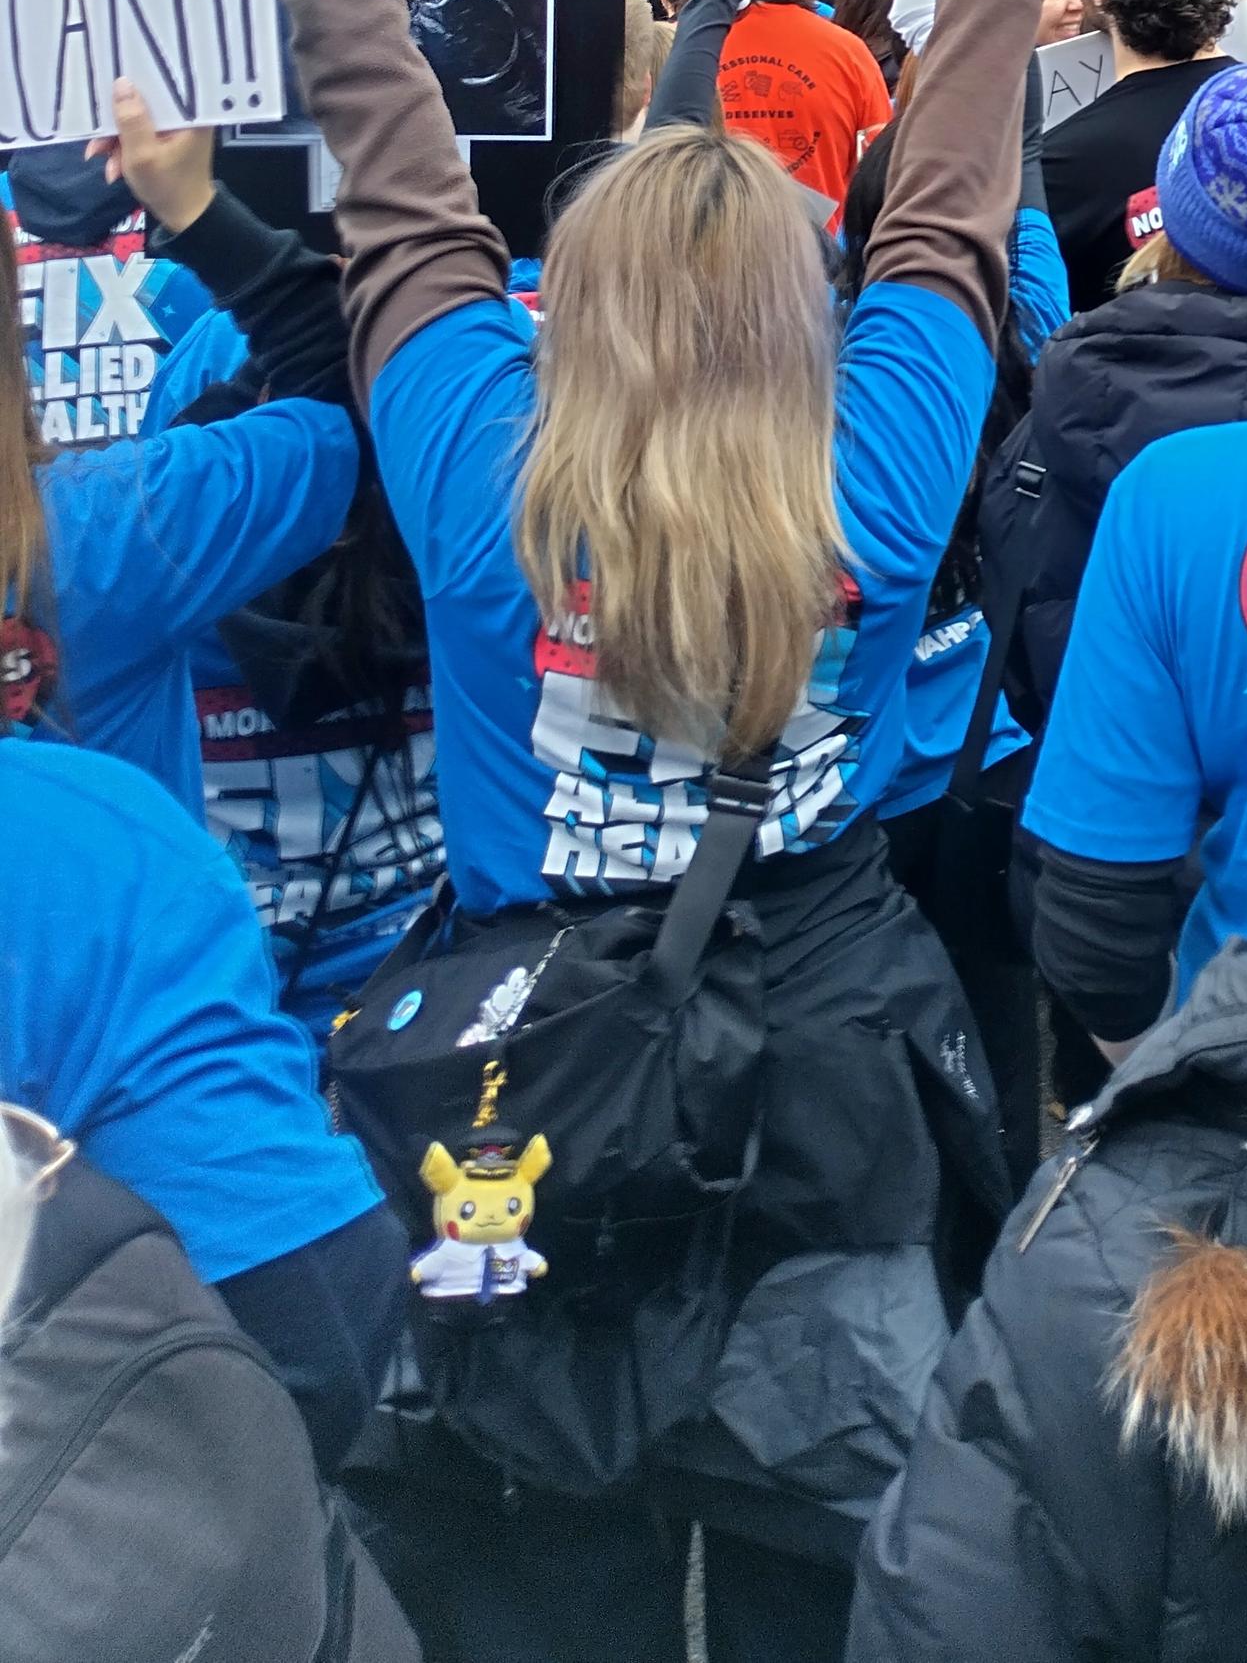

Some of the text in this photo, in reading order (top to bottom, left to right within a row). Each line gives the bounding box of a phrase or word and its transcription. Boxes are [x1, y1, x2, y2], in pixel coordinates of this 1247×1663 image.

[720, 54, 817, 91] ESSIONAL CARE
[725, 109, 796, 121] DESERVES
[1131, 207, 1164, 237] NO
[42, 343, 157, 402] LIED
